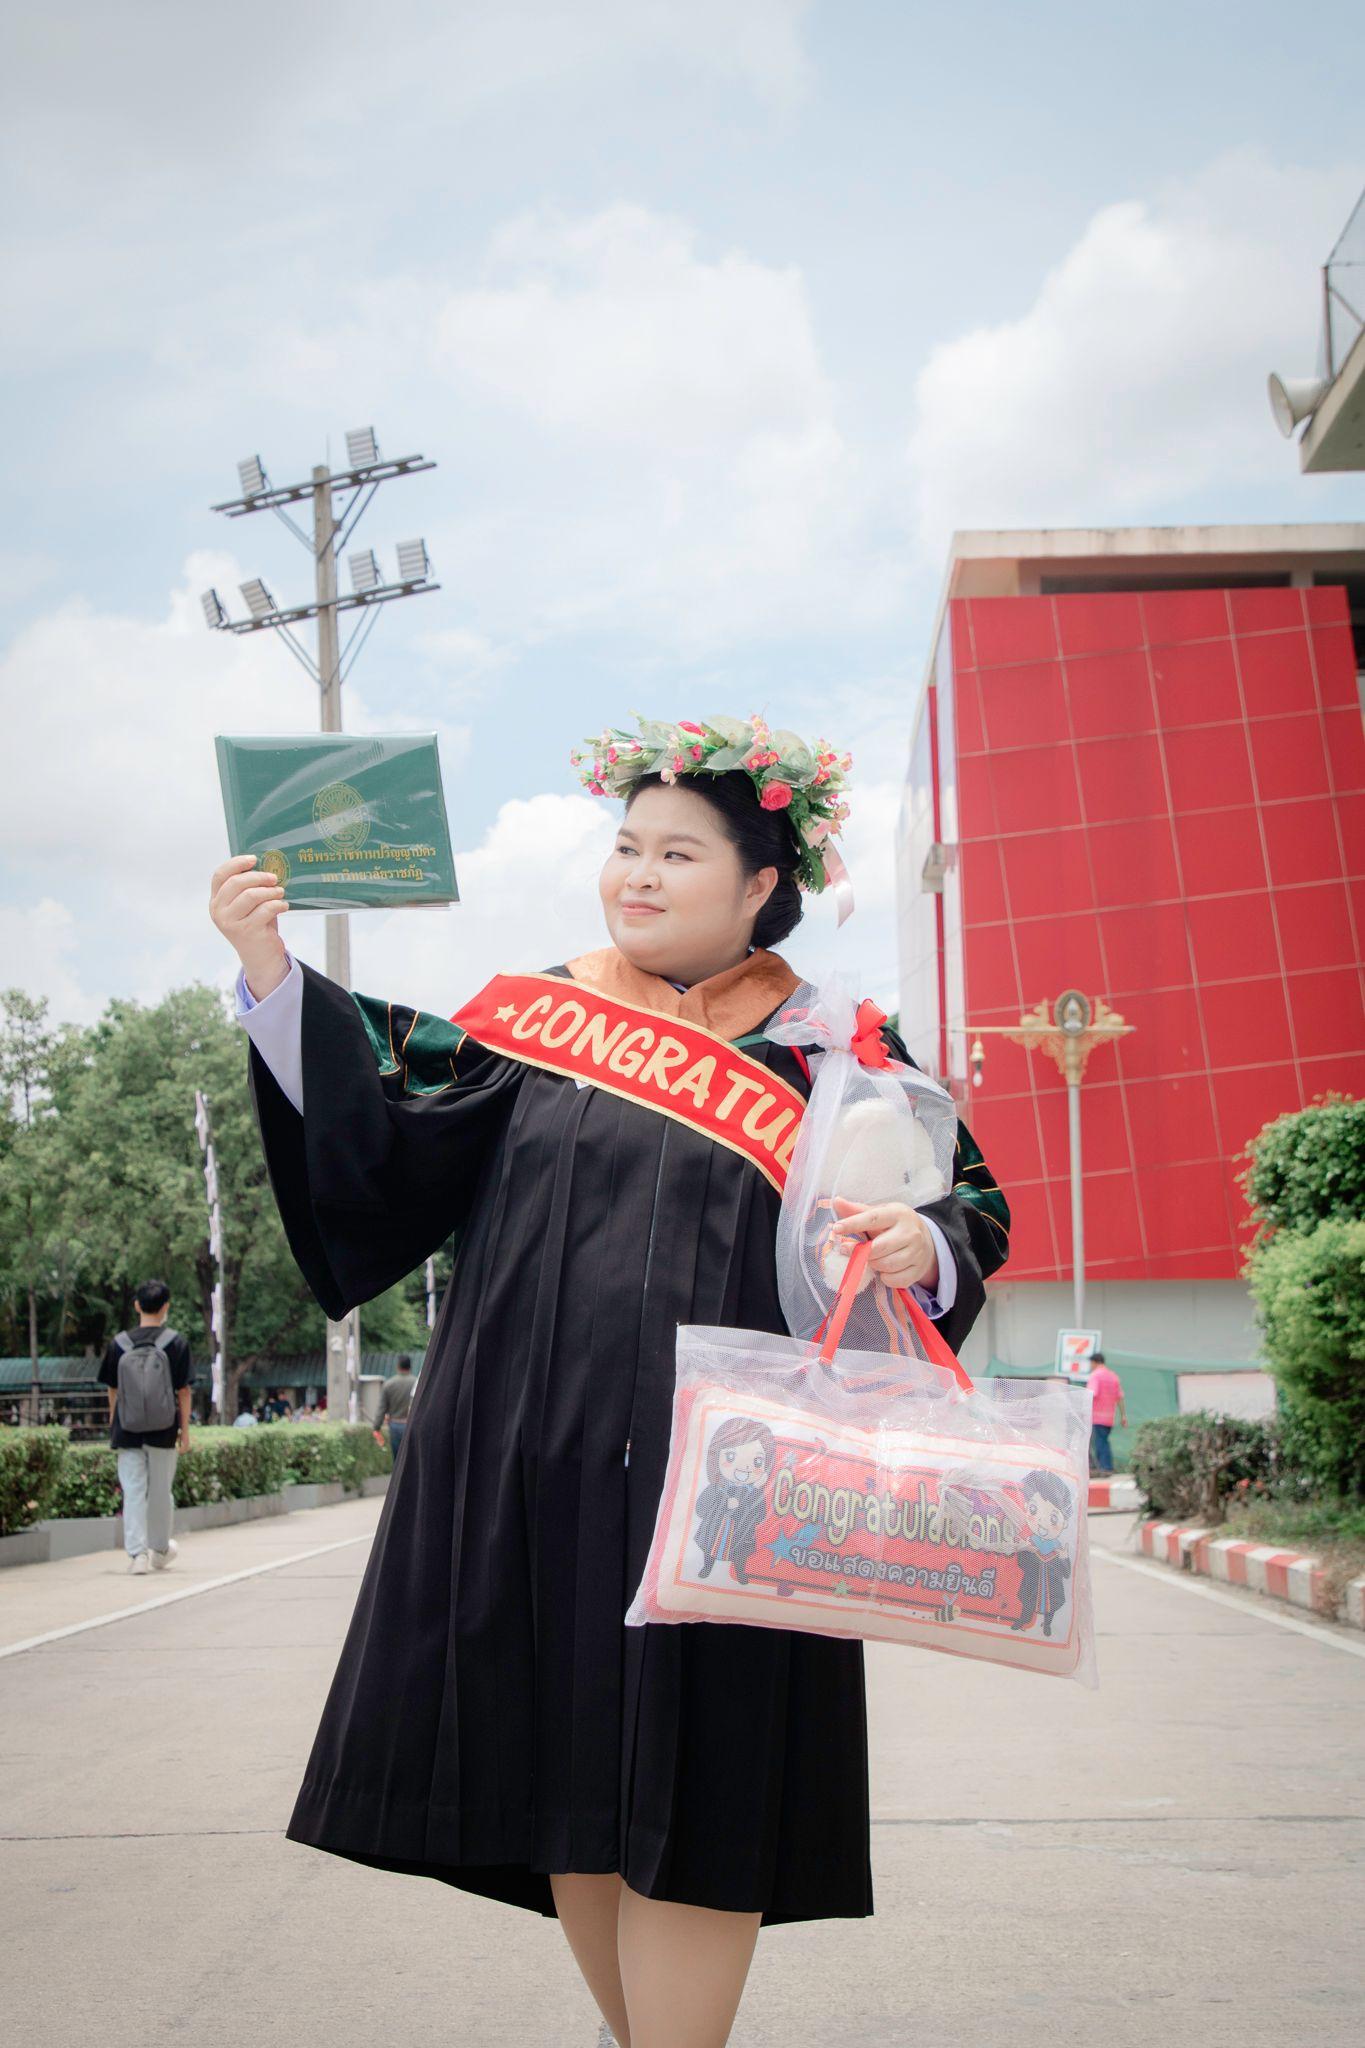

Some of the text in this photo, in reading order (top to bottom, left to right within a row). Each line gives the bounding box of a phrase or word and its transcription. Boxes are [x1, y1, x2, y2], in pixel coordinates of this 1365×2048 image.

[790, 1547, 996, 1599] ขอแสดงความยินดี
